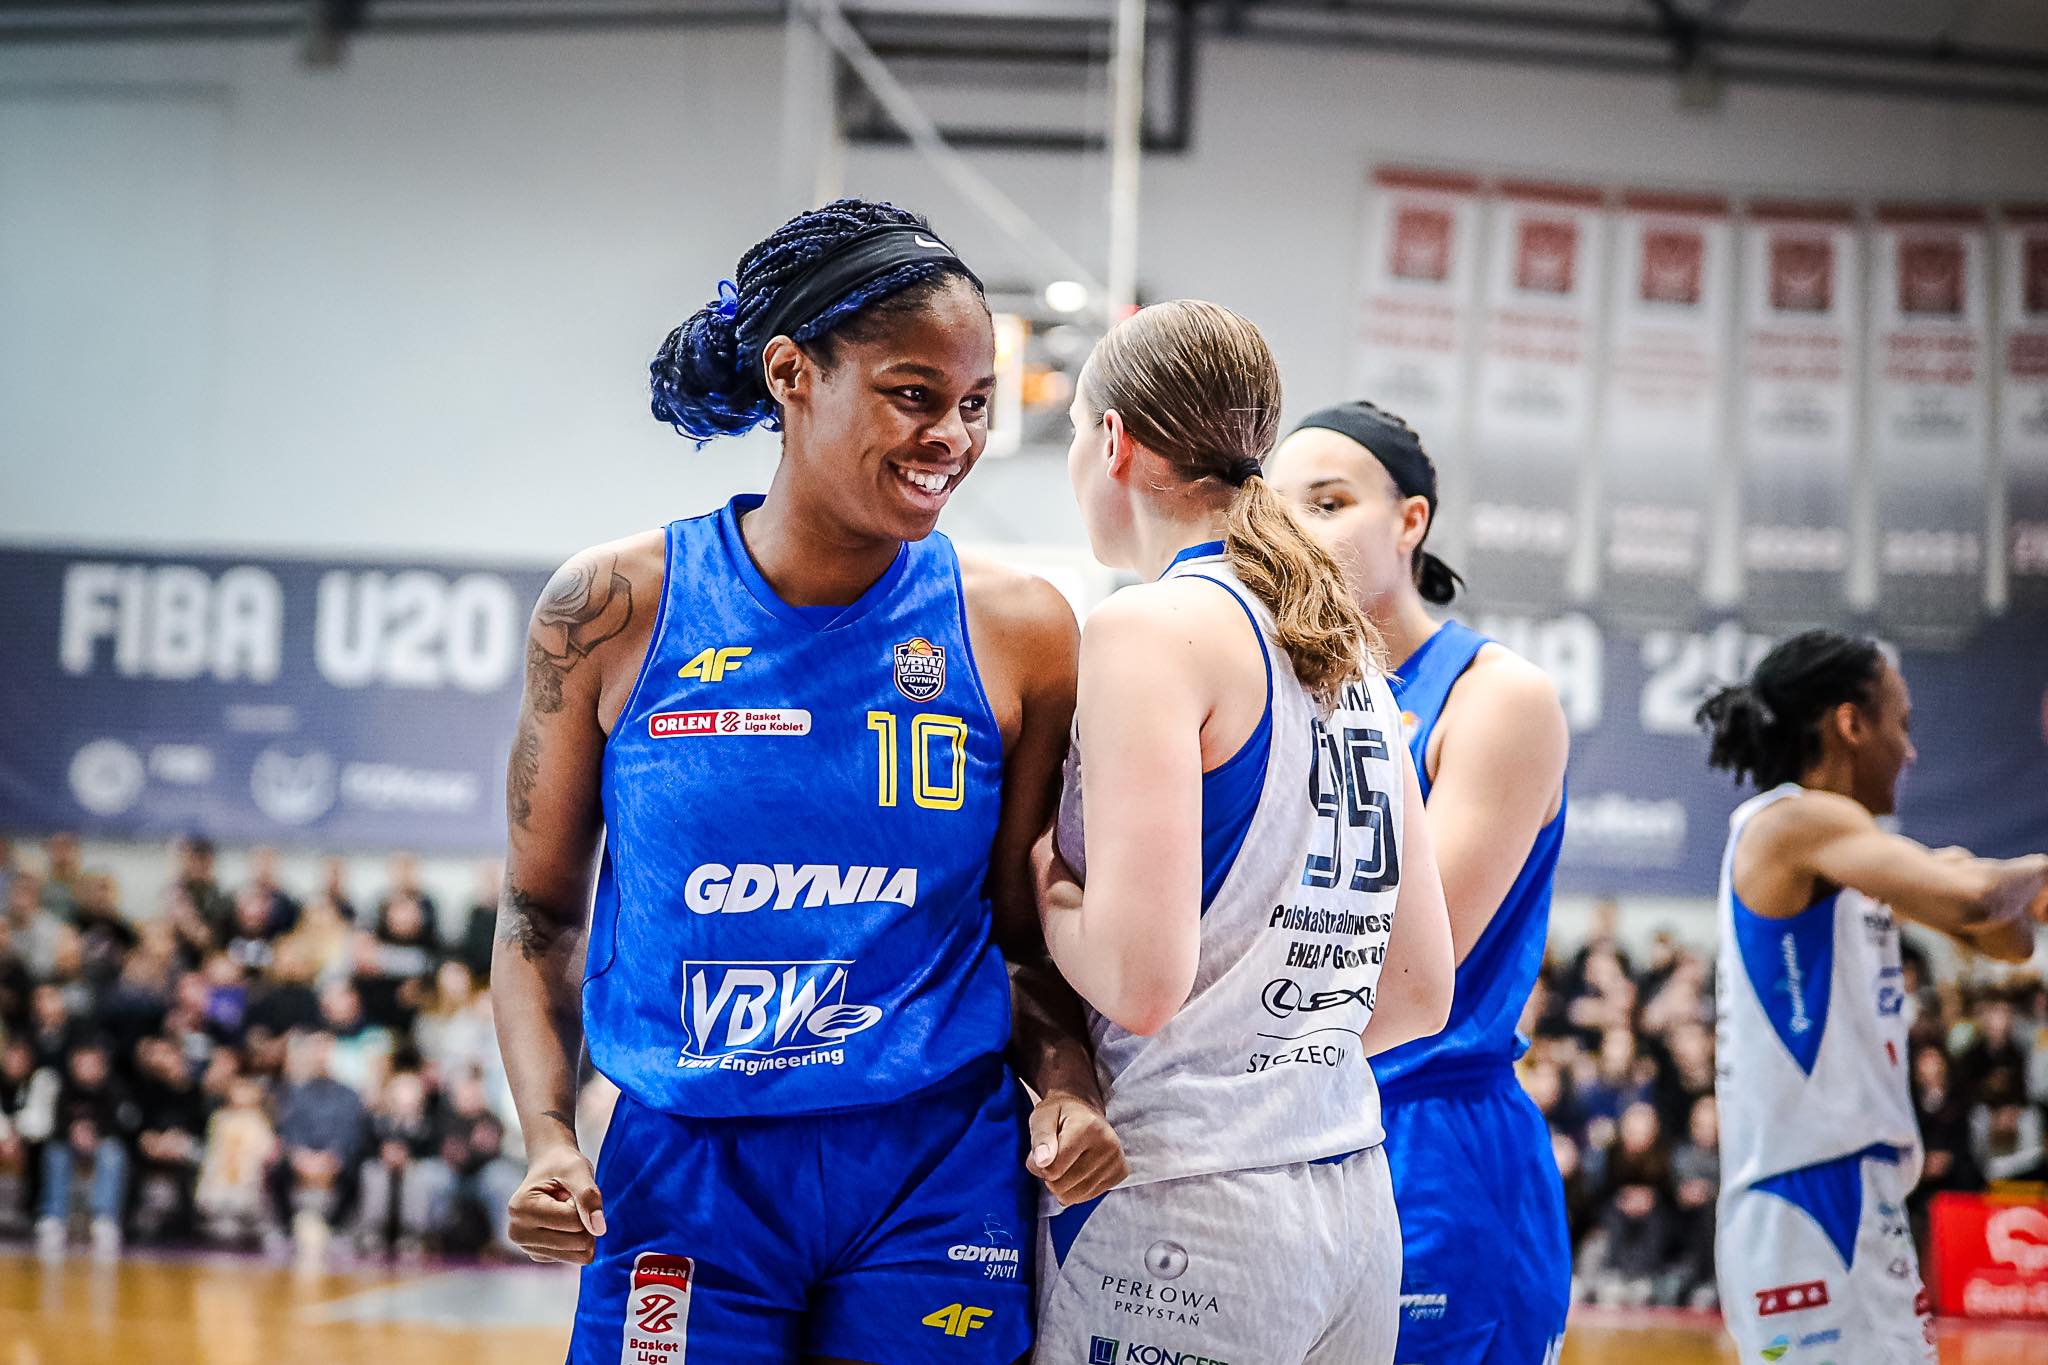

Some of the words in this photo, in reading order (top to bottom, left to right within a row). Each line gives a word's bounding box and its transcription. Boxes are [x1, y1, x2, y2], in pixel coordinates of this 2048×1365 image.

[60, 562, 284, 685] FIBA
[315, 568, 520, 692] U20
[678, 647, 752, 682] 4F
[896, 656, 944, 676] VBW
[902, 676, 938, 684] GDYNIA
[654, 716, 711, 732] ORLEN
[745, 712, 781, 721] Basket
[745, 722, 766, 732] Liga
[867, 711, 967, 811] 10
[1302, 717, 1400, 893] 95
[684, 863, 918, 914] GDYNIA
[692, 966, 845, 1055] VBW
[719, 1048, 844, 1076] Engineering
[1246, 1045, 1346, 1074] SZCZECI
[947, 1244, 1019, 1263] GDYNIA
[640, 1267, 687, 1279] ORLEN
[1101, 1275, 1219, 1313] PERŁOWA
[922, 1303, 993, 1337] 4F
[1114, 1300, 1200, 1326] PRZYSTAŃ
[630, 1338, 679, 1353] Basket
[638, 1351, 668, 1365] Liga
[1126, 1342, 1230, 1365] KONC
